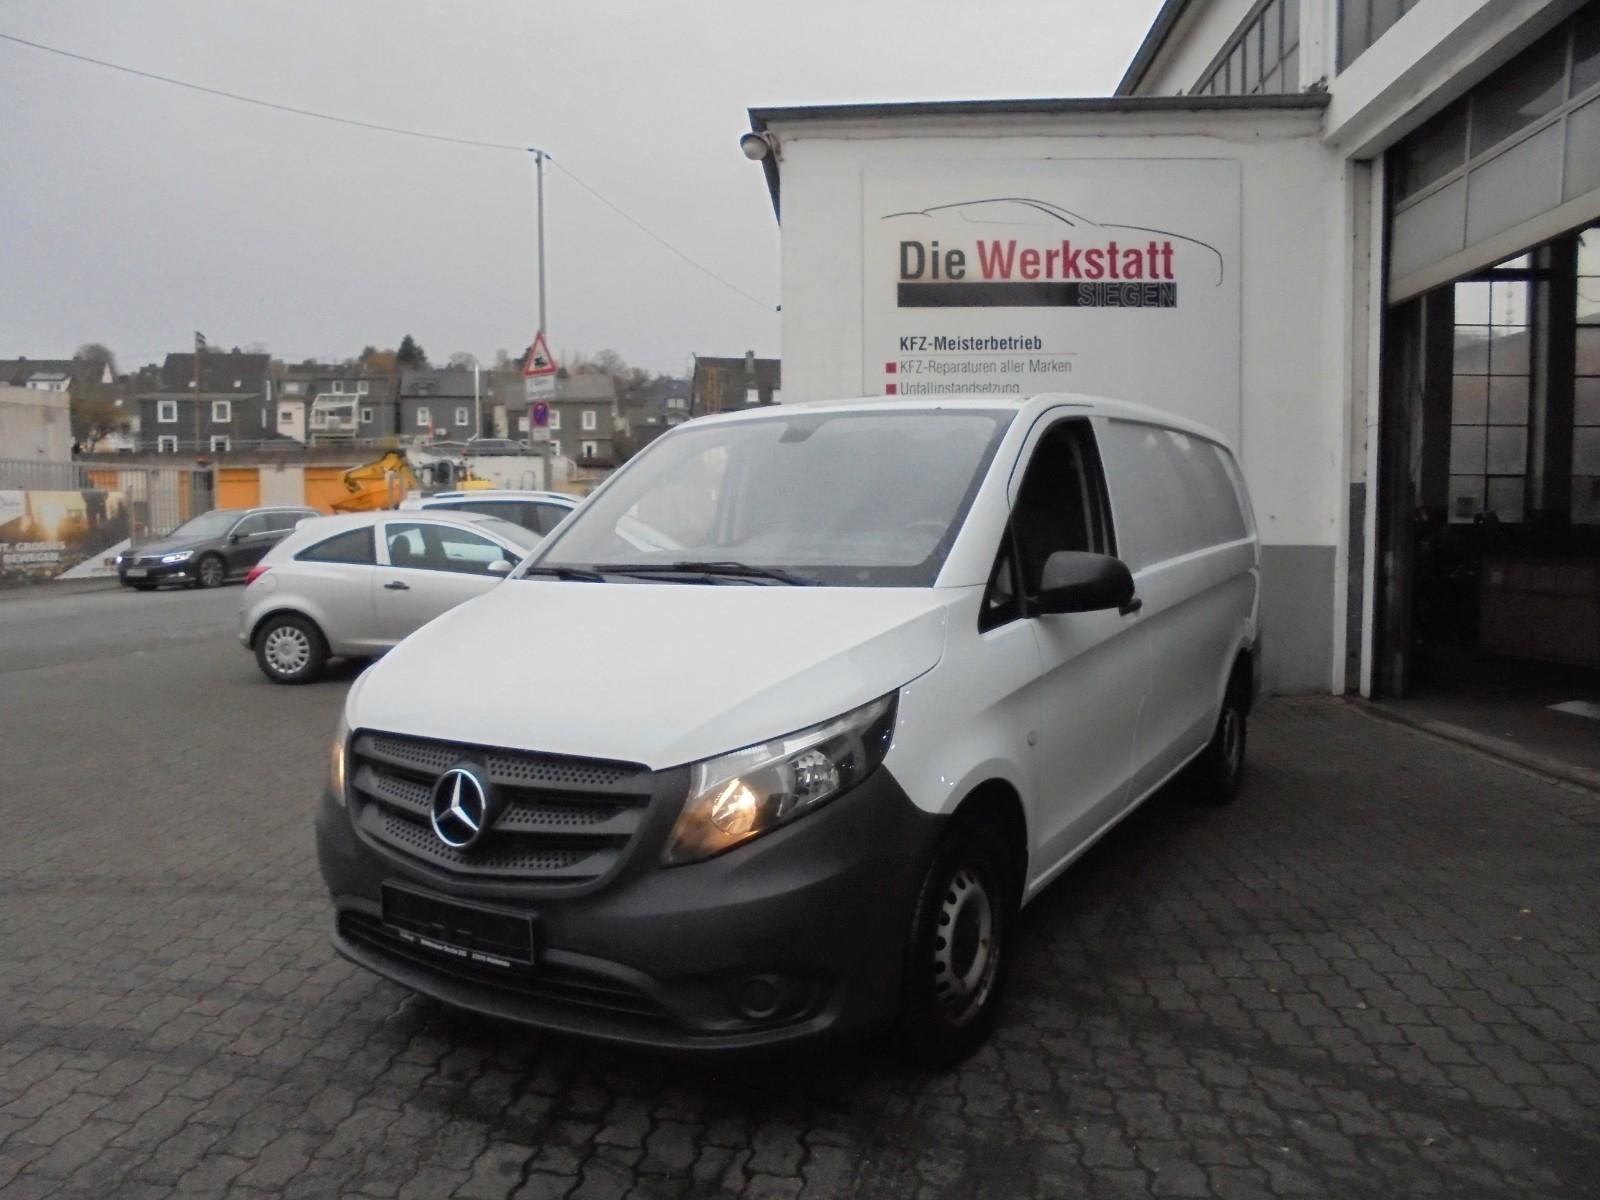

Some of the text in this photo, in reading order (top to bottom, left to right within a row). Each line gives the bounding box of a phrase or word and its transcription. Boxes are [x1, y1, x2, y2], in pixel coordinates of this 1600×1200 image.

[899, 240, 1175, 281] Die Werkstatt
[1077, 282, 1177, 307] SIEGEN
[899, 336, 1042, 352] KFZ-Meisterbetrieb
[900, 359, 1073, 376] KFZ-Reparaturen aller Marken
